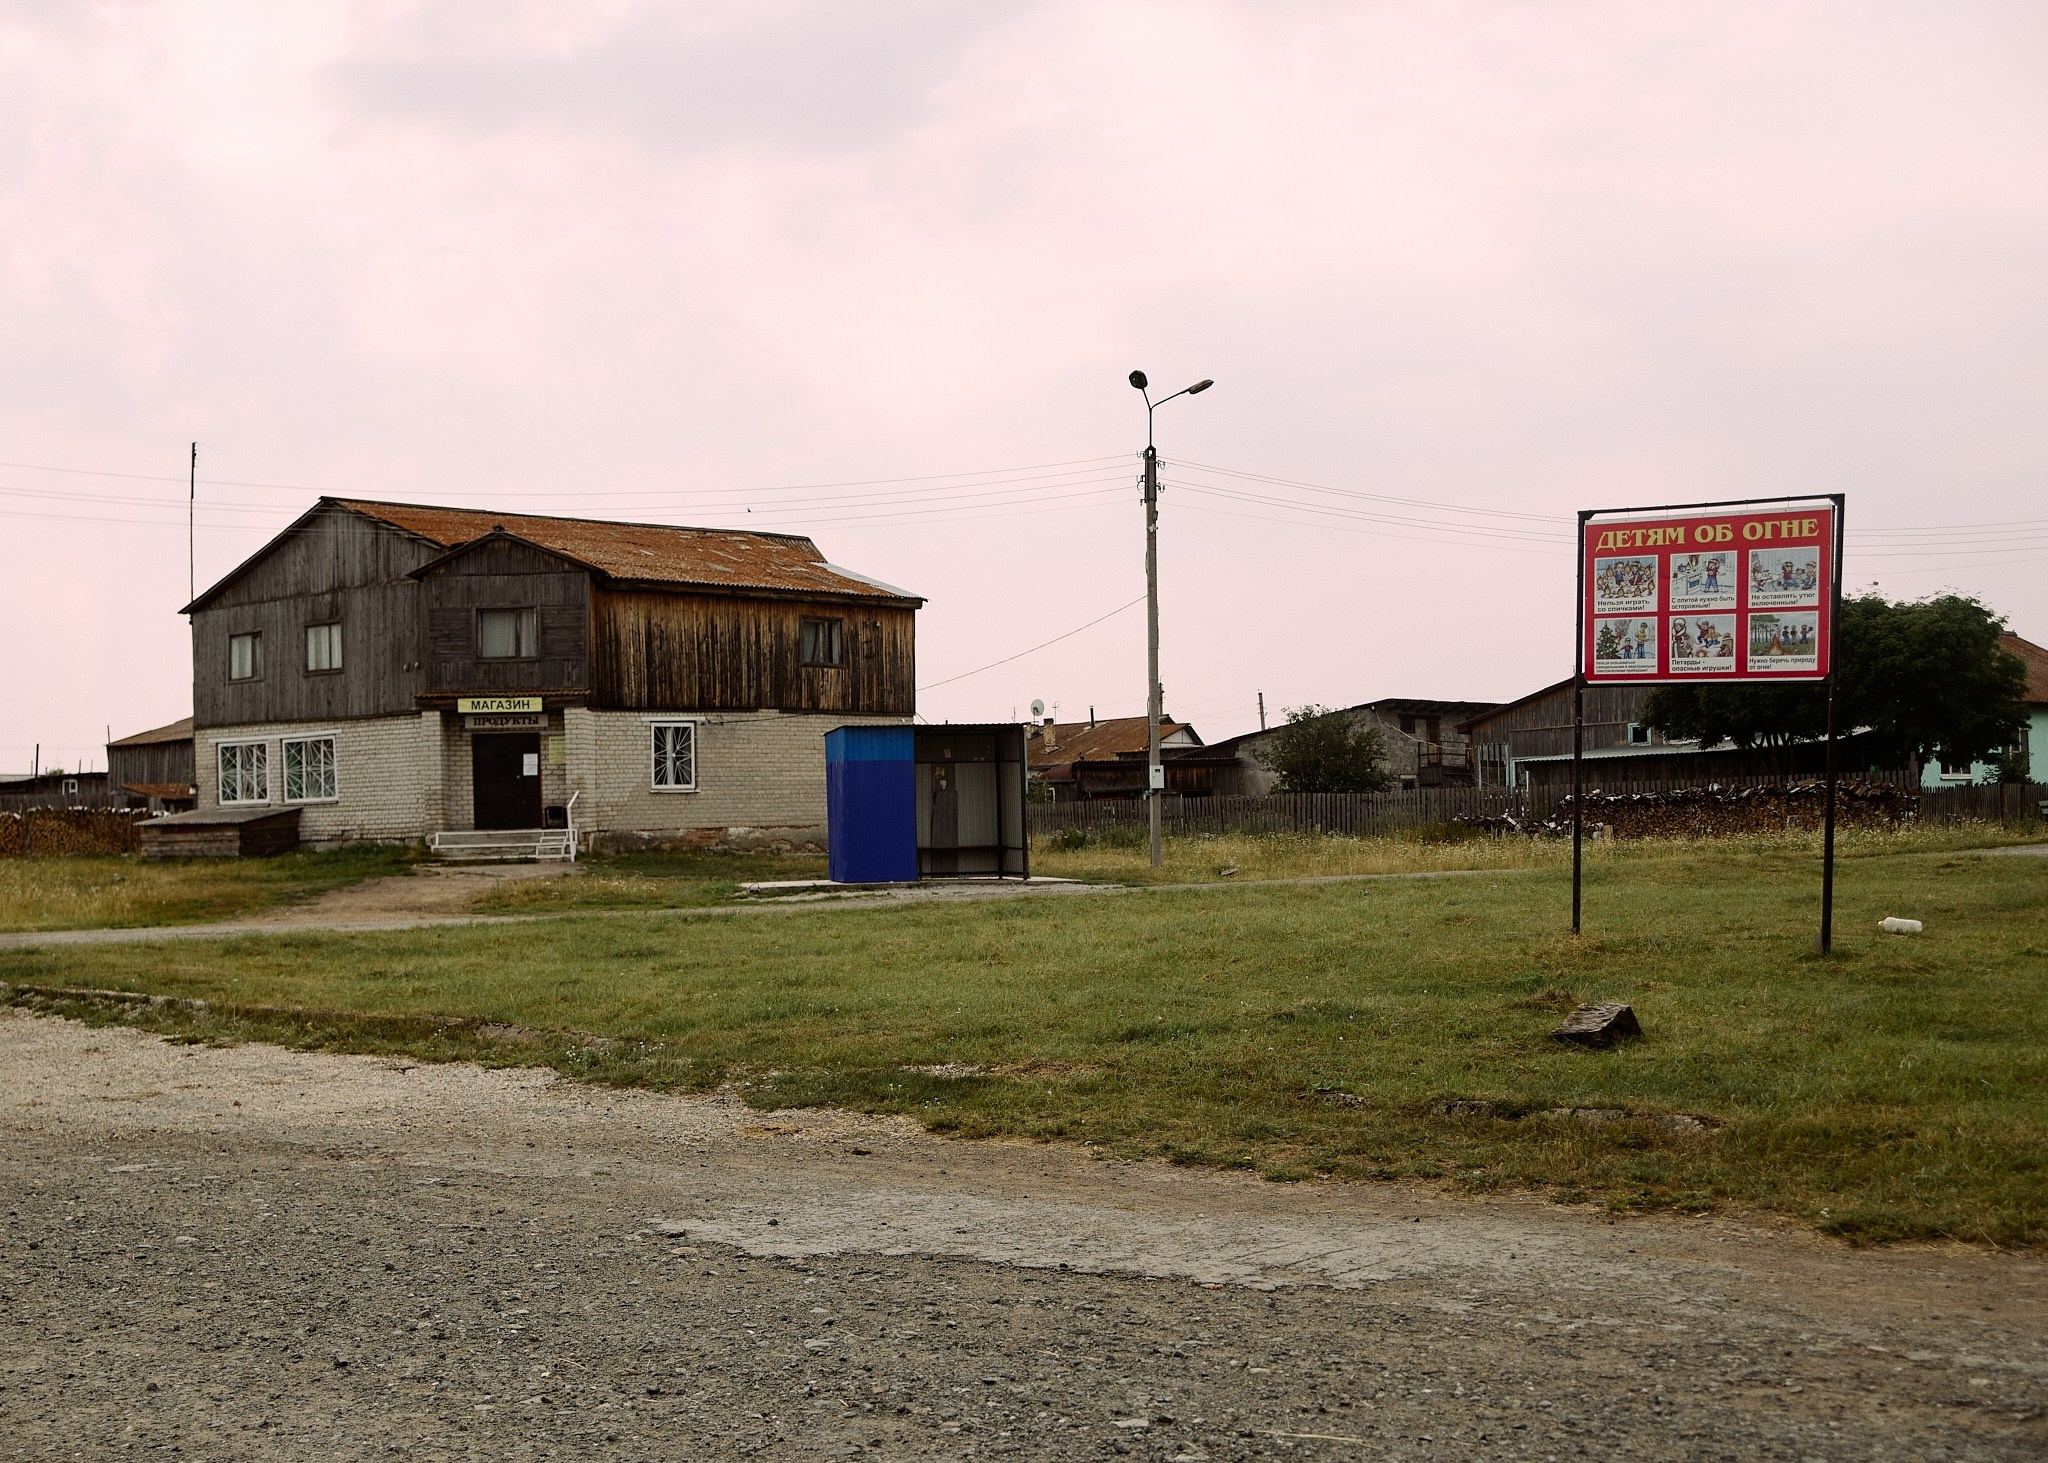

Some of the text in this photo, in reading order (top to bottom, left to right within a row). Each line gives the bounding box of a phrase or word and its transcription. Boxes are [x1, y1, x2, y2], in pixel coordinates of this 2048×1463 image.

[1595, 518, 1819, 552] ДЕТЯМ ОБ ОГНЕ
[471, 700, 530, 710] МАГАЗИН
[473, 716, 539, 727] ПРОДУКТЫ
